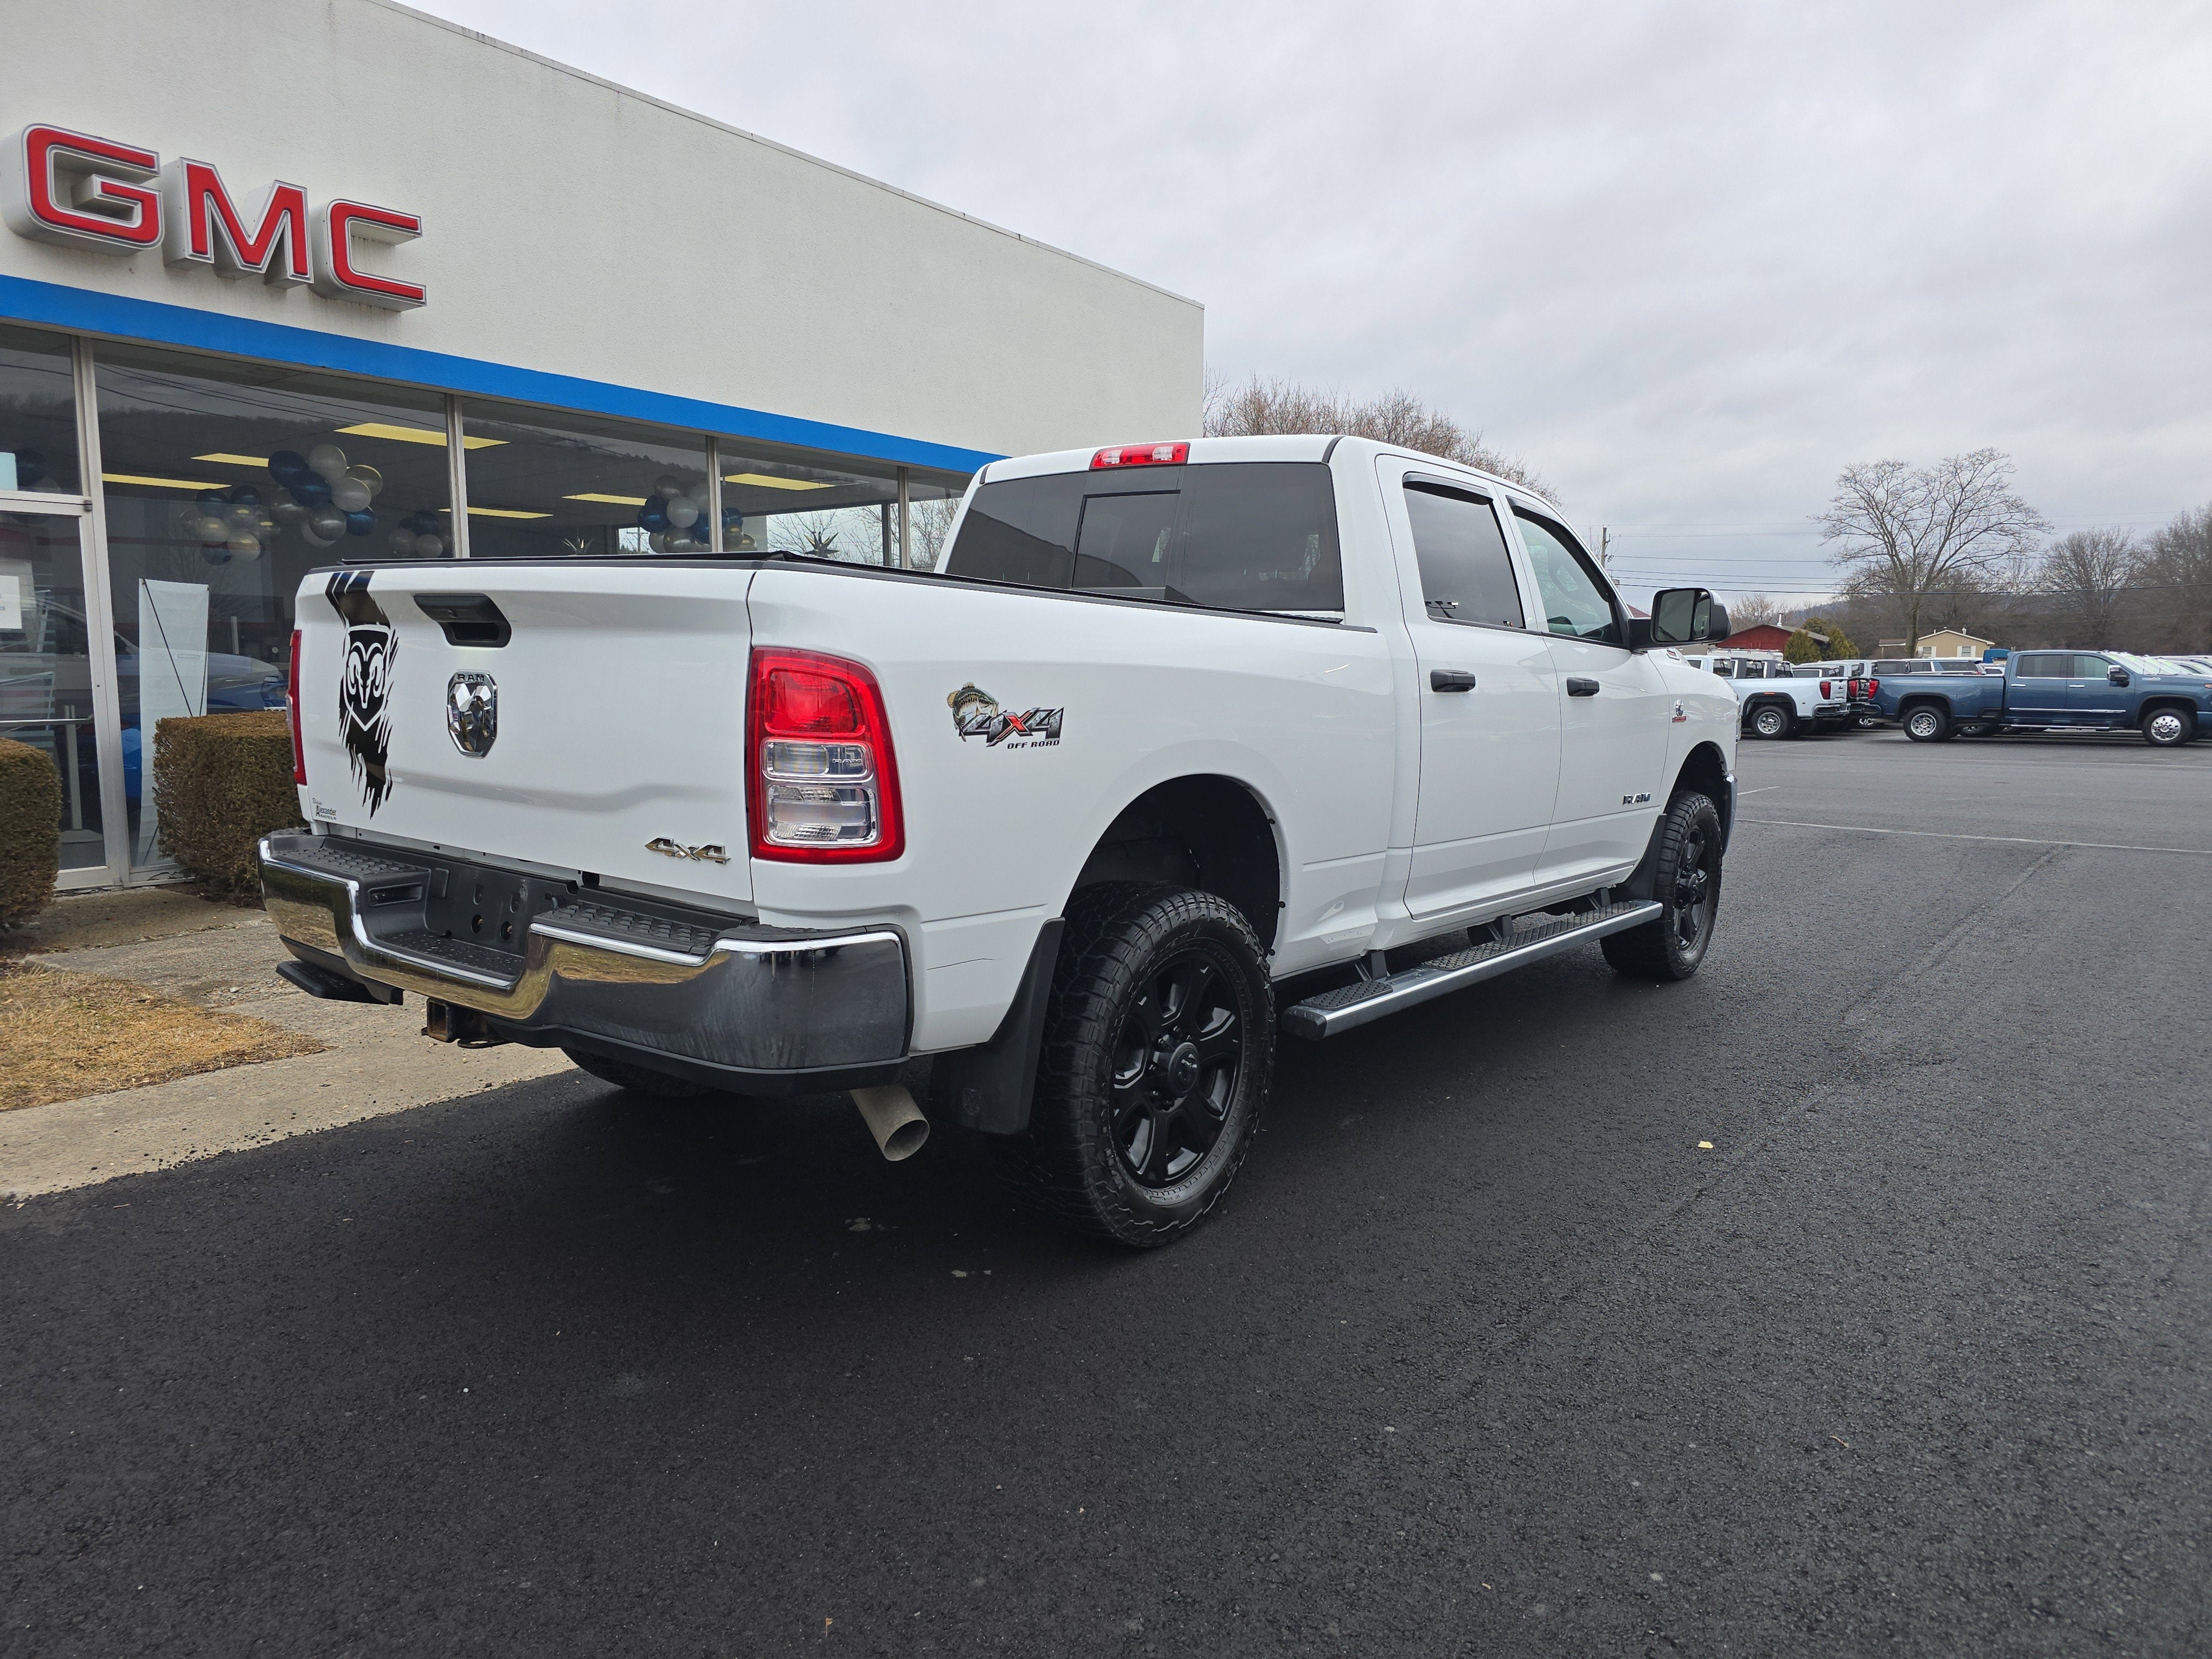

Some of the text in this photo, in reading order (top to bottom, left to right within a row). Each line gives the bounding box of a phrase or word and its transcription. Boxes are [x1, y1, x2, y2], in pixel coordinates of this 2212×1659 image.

[21, 123, 427, 308] GMC
[457, 673, 485, 681] RAM
[1031, 740, 1060, 748] ROAD
[1622, 792, 1651, 805] RAM
